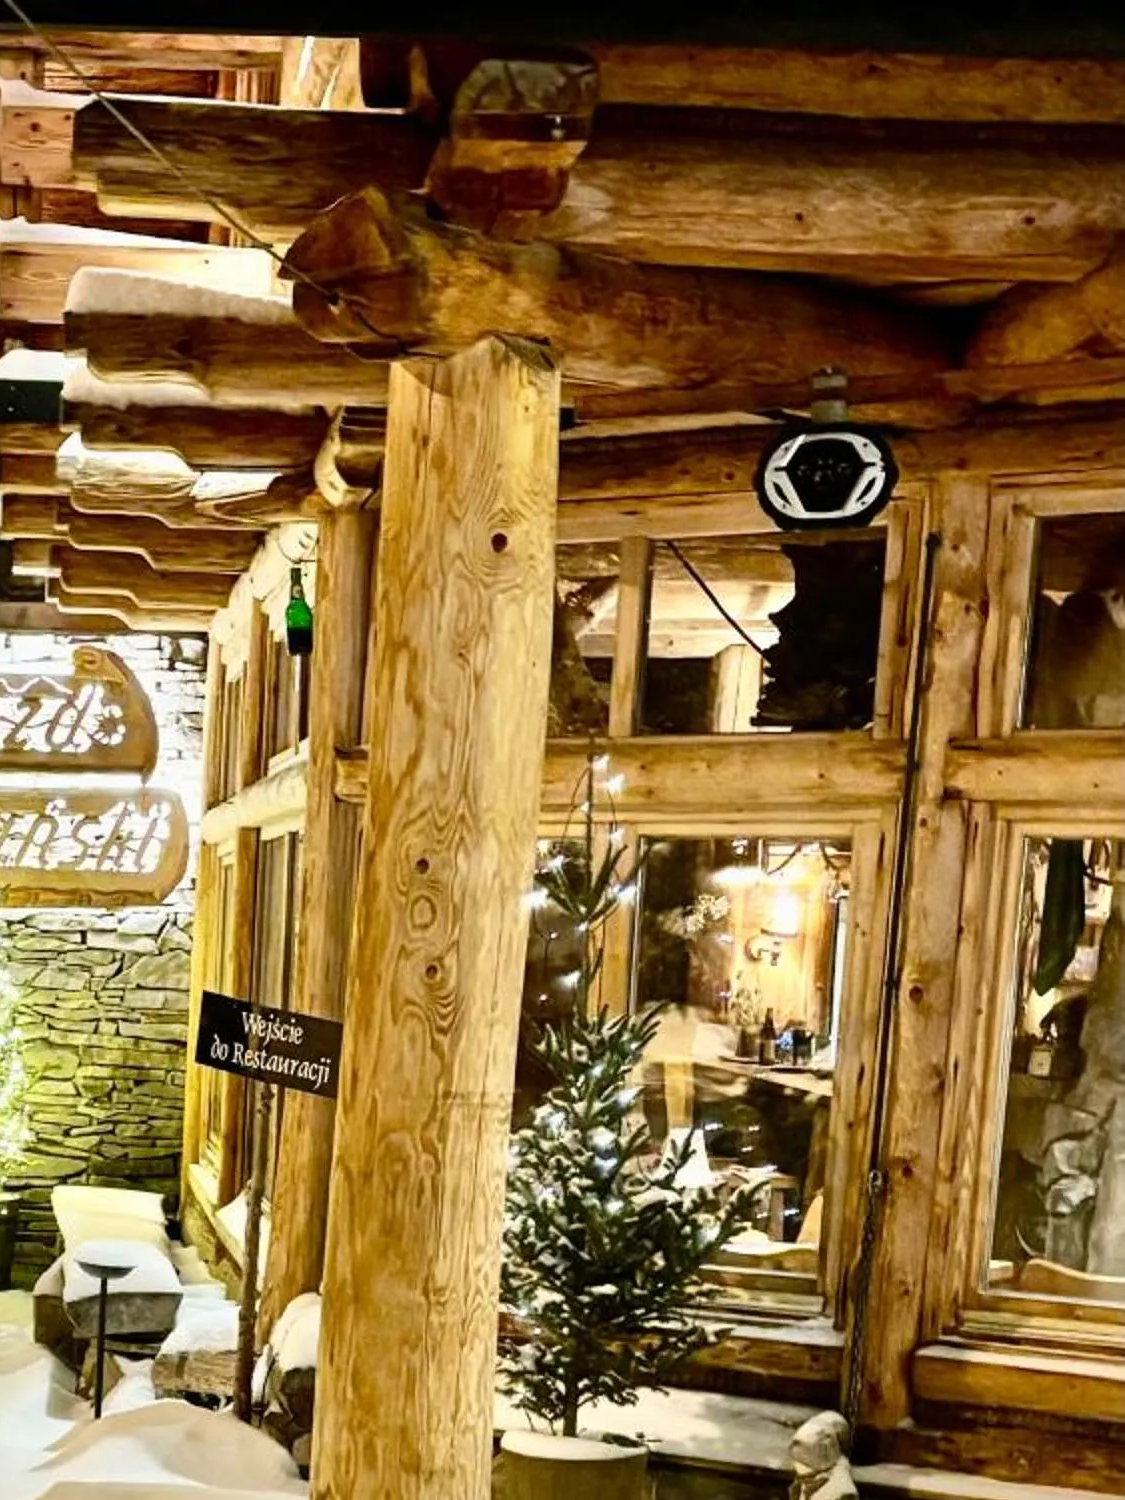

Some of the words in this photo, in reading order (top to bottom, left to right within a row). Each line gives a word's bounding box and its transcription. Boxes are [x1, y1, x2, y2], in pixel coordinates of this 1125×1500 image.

[241, 1011, 304, 1047] Wejście
[210, 1033, 229, 1060] do
[231, 1042, 332, 1090] Restauracji
